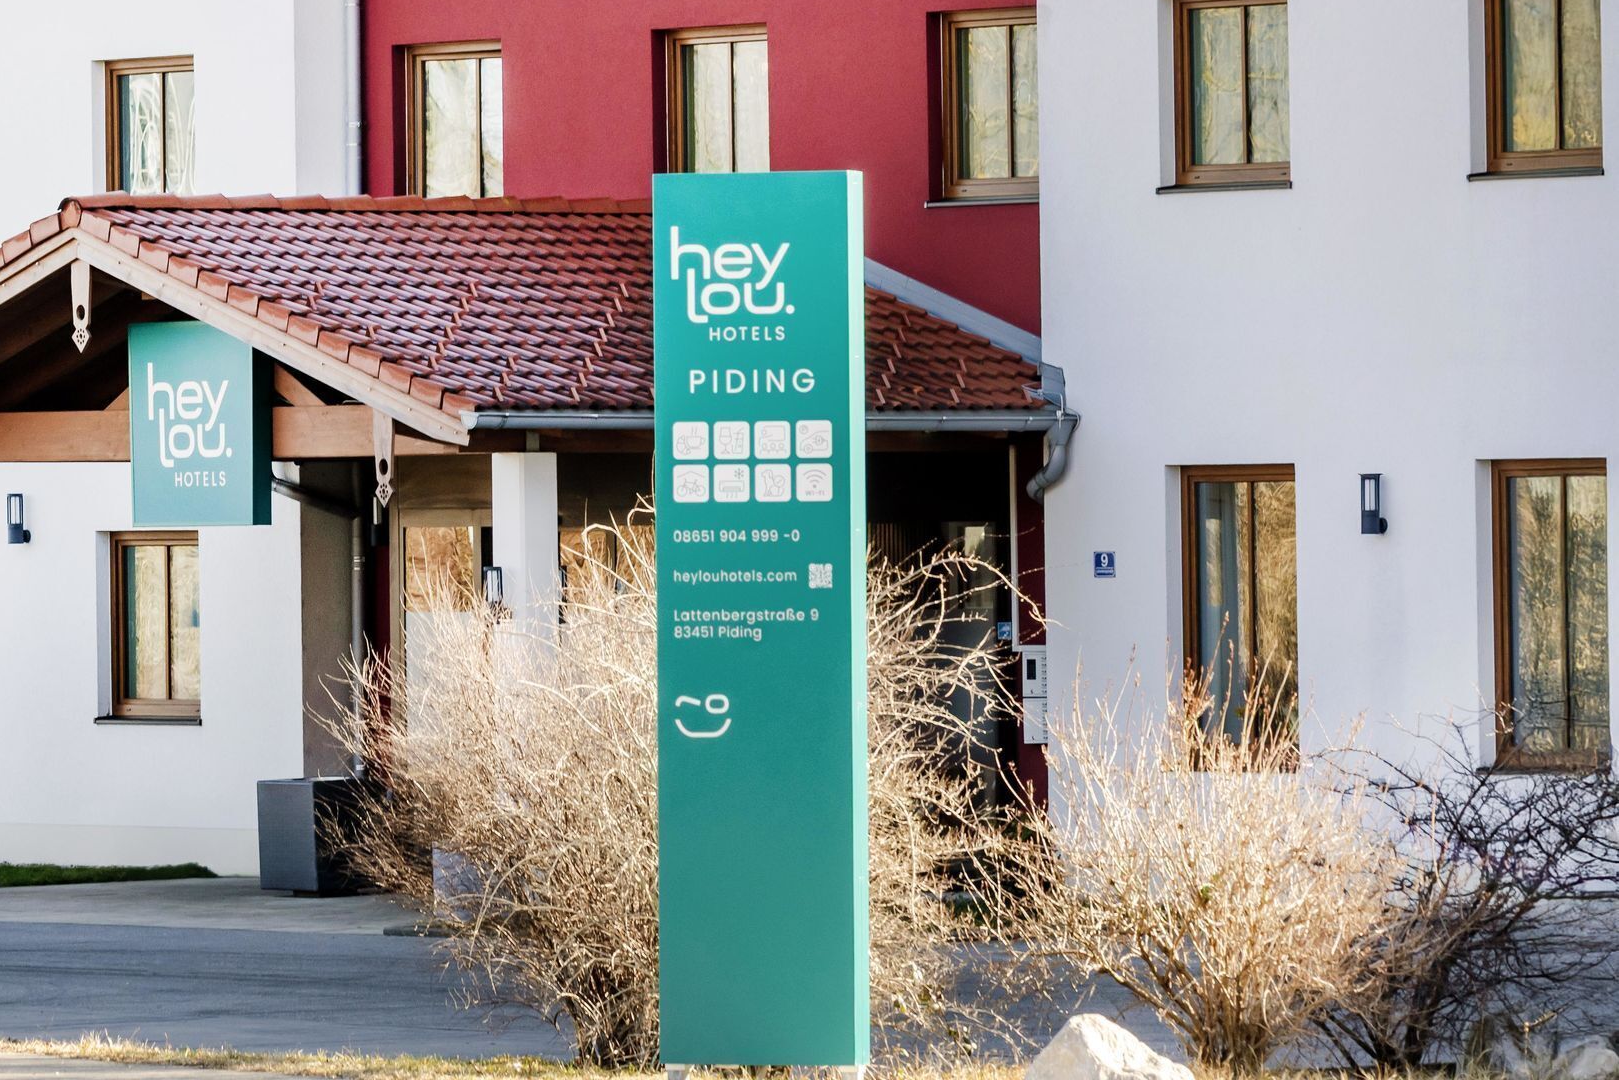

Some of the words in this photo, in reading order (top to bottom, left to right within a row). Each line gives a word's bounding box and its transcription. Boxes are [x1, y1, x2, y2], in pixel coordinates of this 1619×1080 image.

[670, 226, 790, 290] hey
[687, 268, 795, 323] lou.
[709, 326, 785, 341] HOTELS
[689, 368, 817, 394] PIDING
[147, 362, 229, 432] hey
[159, 408, 233, 468] lou.
[174, 471, 227, 487] HOTELS
[673, 530, 715, 543] 08651
[719, 530, 746, 542] 904
[751, 530, 778, 542] 999
[1100, 553, 1109, 568] 9
[673, 570, 797, 585] heylouhotels.com
[674, 609, 805, 624] Lattenbergstraße
[810, 608, 819, 621] 9
[674, 626, 713, 638] 83451
[718, 626, 762, 641] Piding
